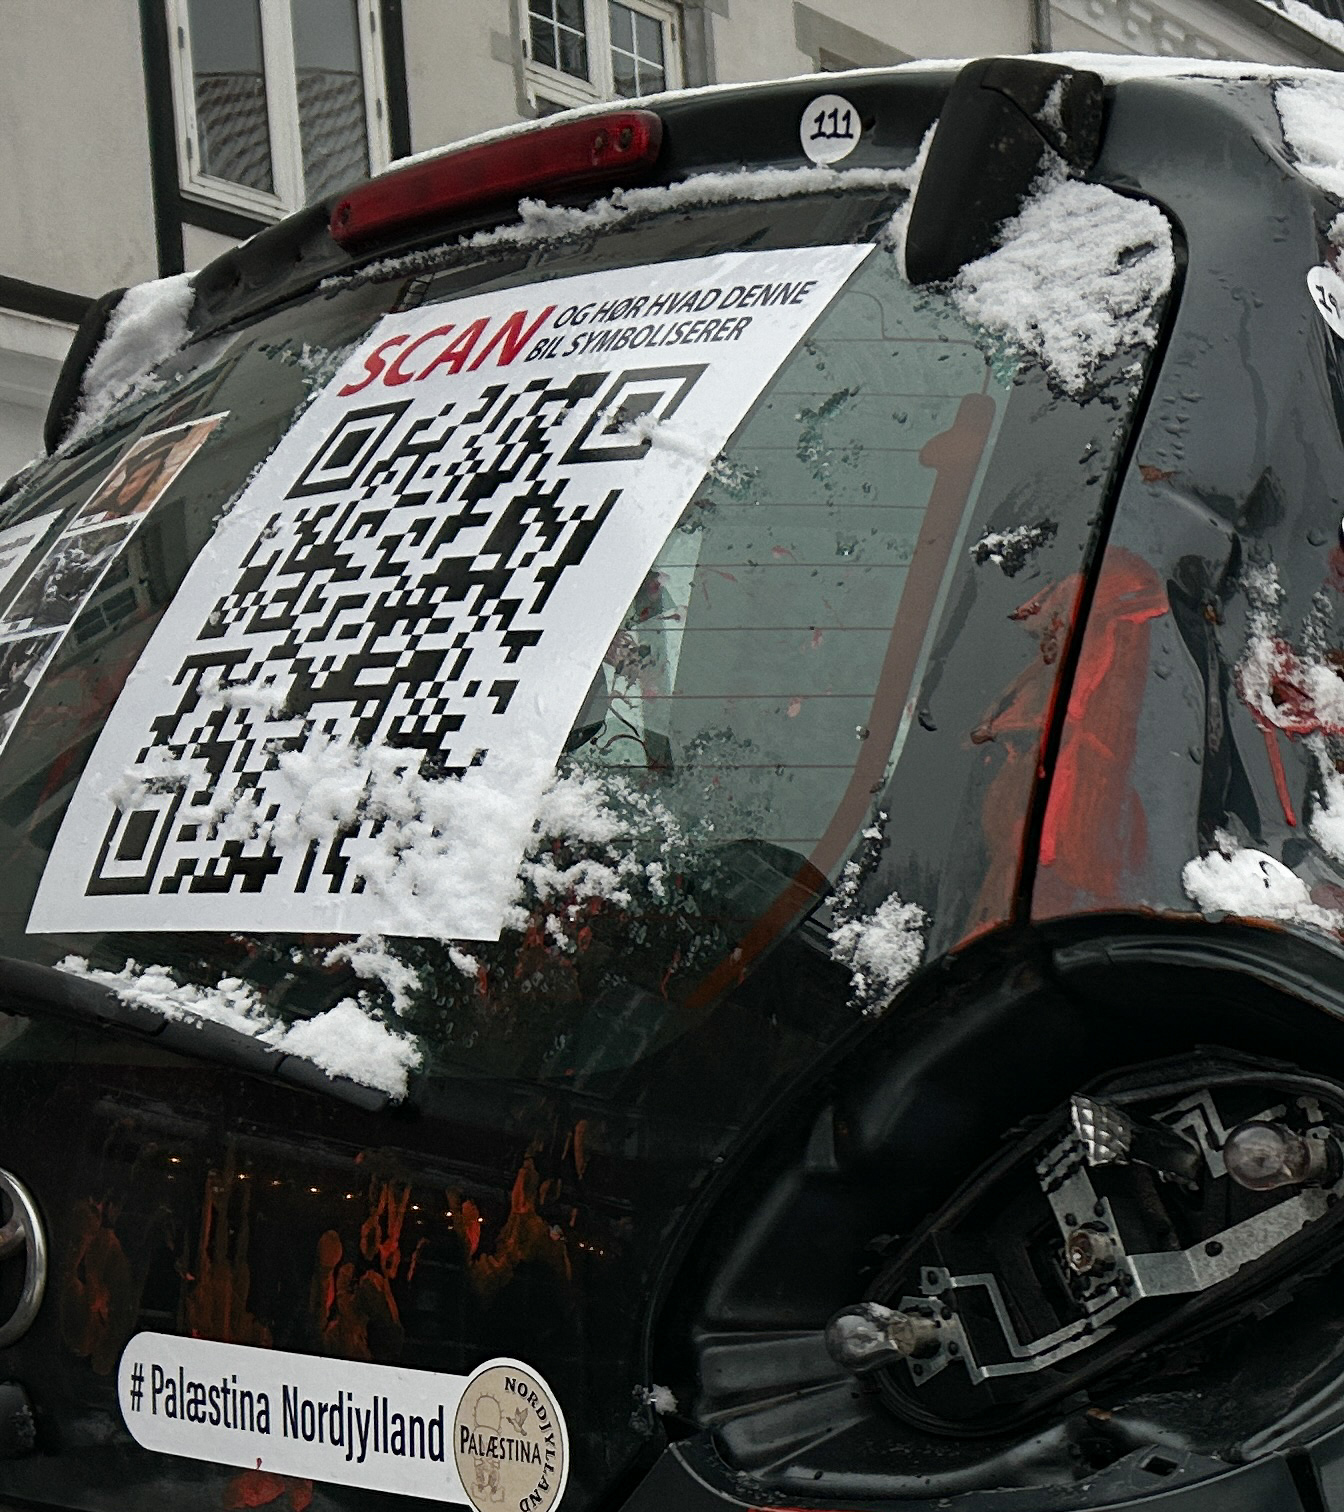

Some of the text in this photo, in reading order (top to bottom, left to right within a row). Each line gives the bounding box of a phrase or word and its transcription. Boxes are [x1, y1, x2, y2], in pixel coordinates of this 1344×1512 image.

[811, 109, 855, 141] 111
[338, 281, 818, 397] SCAN OG HØR HVAD DENNE
[525, 316, 754, 362] BIL SYMBOLISERER
[131, 1362, 446, 1465] # Palæstina Nordjylland
[460, 1425, 542, 1465] PALÆSTINA
